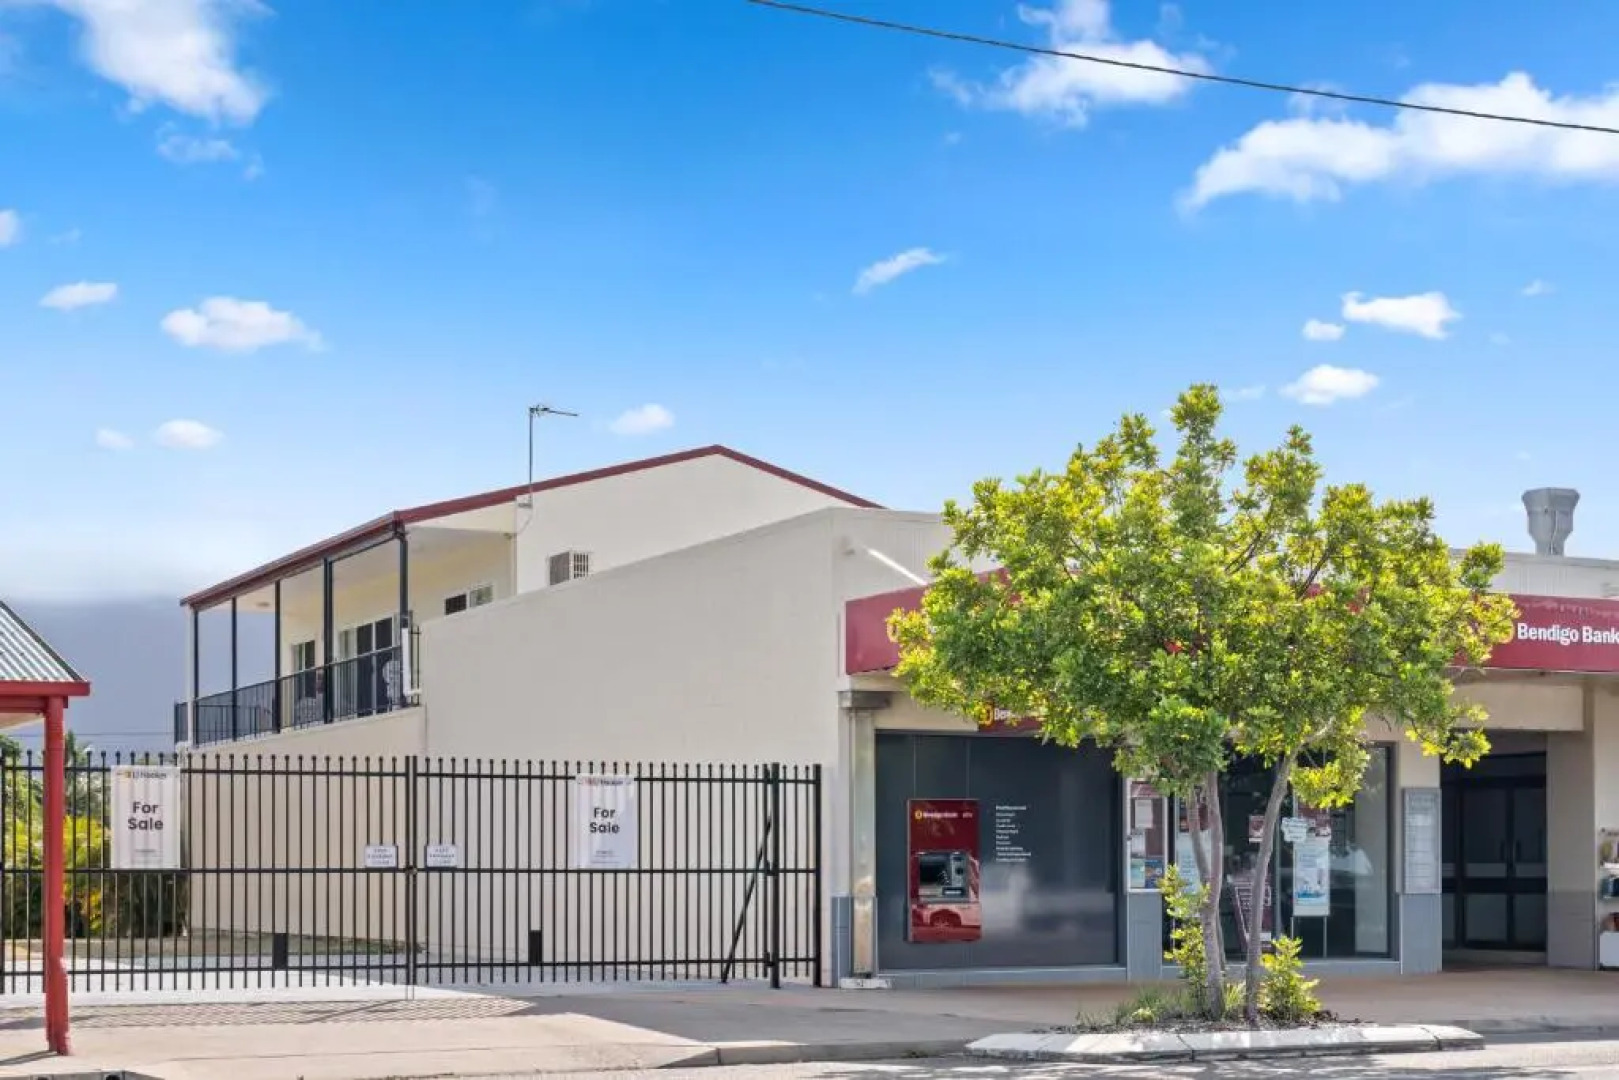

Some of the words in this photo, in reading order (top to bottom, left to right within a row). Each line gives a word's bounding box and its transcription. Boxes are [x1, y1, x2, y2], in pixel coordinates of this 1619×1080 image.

[1517, 622, 1579, 646] Bendigo
[1582, 625, 1619, 643] Bank
[132, 801, 159, 814] For
[593, 807, 616, 818] For
[127, 817, 164, 830] Sale
[589, 821, 621, 834] Sale
